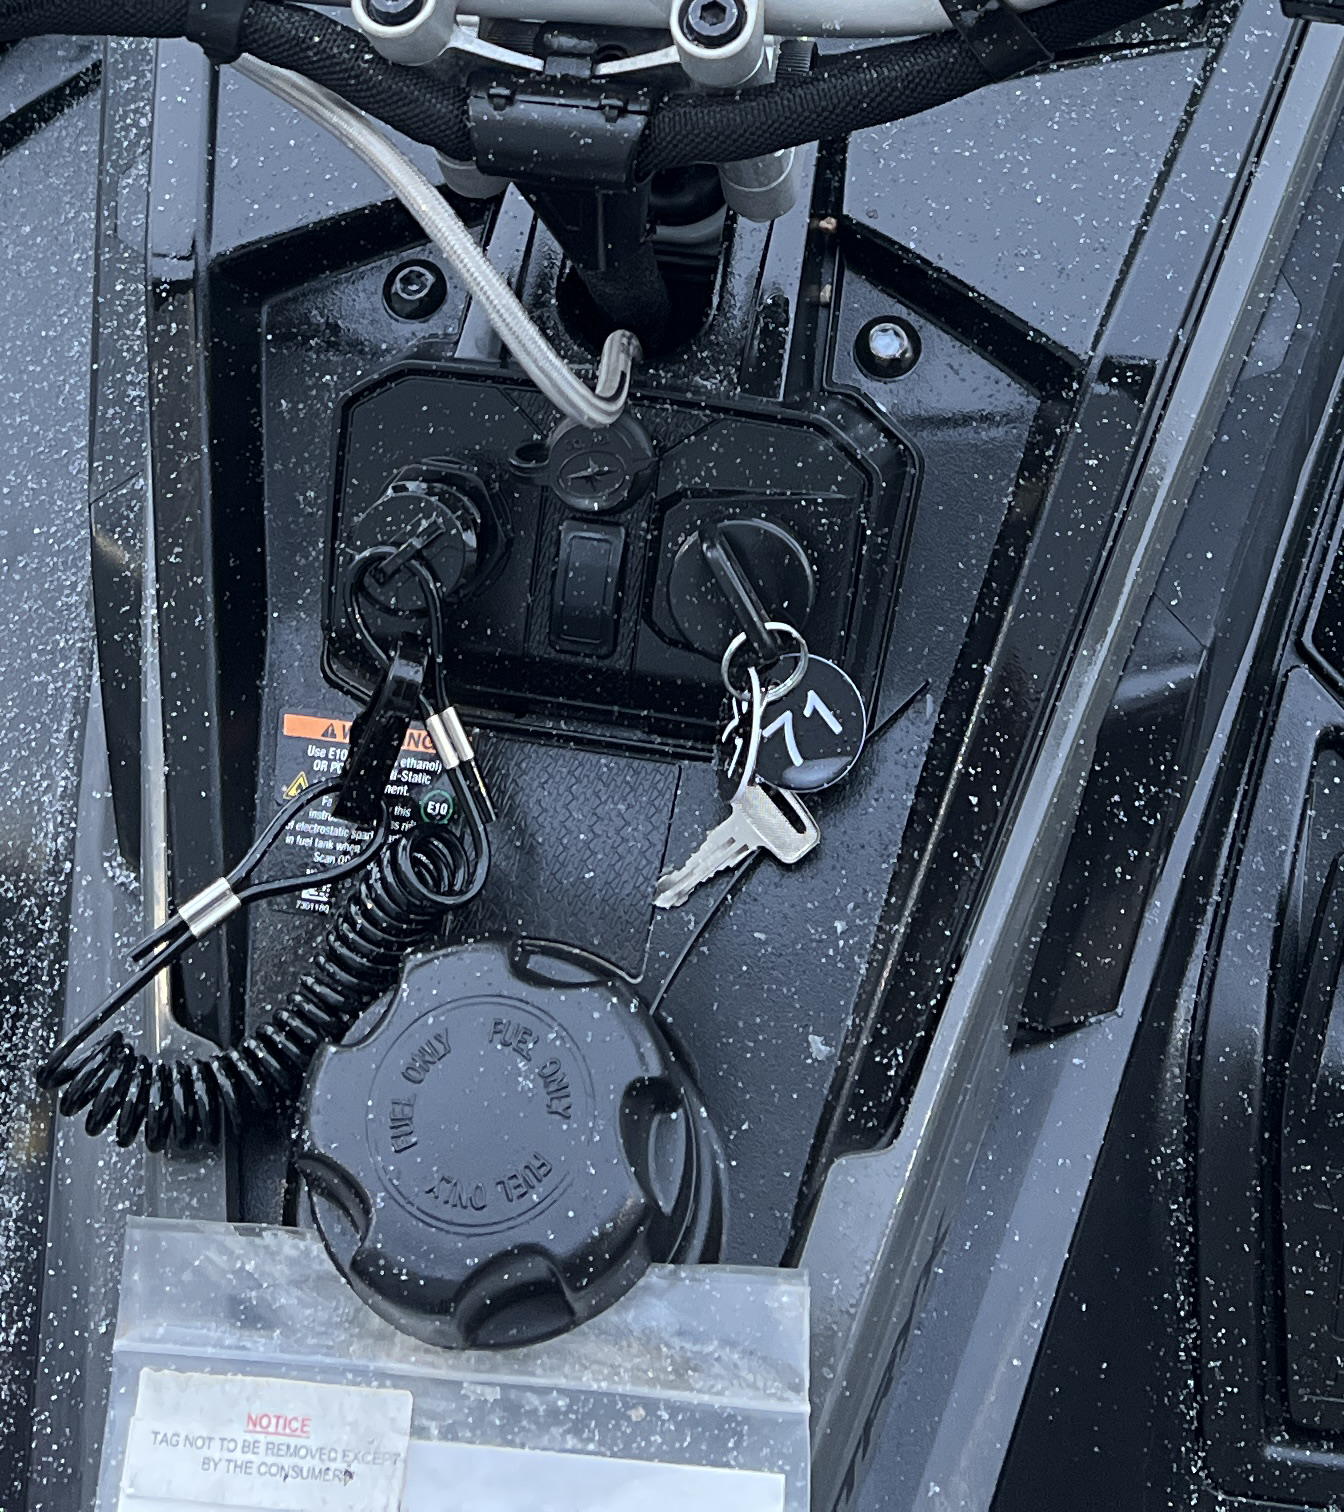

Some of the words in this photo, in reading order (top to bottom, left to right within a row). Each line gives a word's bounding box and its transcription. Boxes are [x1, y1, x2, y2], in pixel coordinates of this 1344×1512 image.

[307, 745, 326, 759] Use
[328, 747, 348, 761] E10
[313, 759, 328, 772] OR
[394, 805, 412, 818] this
[427, 801, 448, 815] E10
[296, 821, 350, 837] electrostatic
[286, 834, 294, 844] in
[296, 835, 313, 847] fuel
[315, 837, 334, 849] tank
[336, 842, 360, 856] when
[313, 851, 335, 865] Scan
[401, 1026, 452, 1085] ONLY
[490, 1017, 539, 1062] FUEL
[538, 1057, 572, 1120] ONLY
[389, 1092, 418, 1153] FUEL
[496, 1151, 553, 1202] FUEL
[425, 1175, 488, 1211] ONLY
[246, 1412, 311, 1435] NOTICE
[151, 1431, 180, 1448] TAG
[184, 1435, 214, 1452] NOT
[219, 1438, 238, 1453] TO
[241, 1440, 261, 1456] BE
[265, 1442, 338, 1463] REMOVED
[342, 1450, 401, 1467] EXCEPT
[201, 1458, 220, 1472] BY
[225, 1460, 254, 1476] THE
